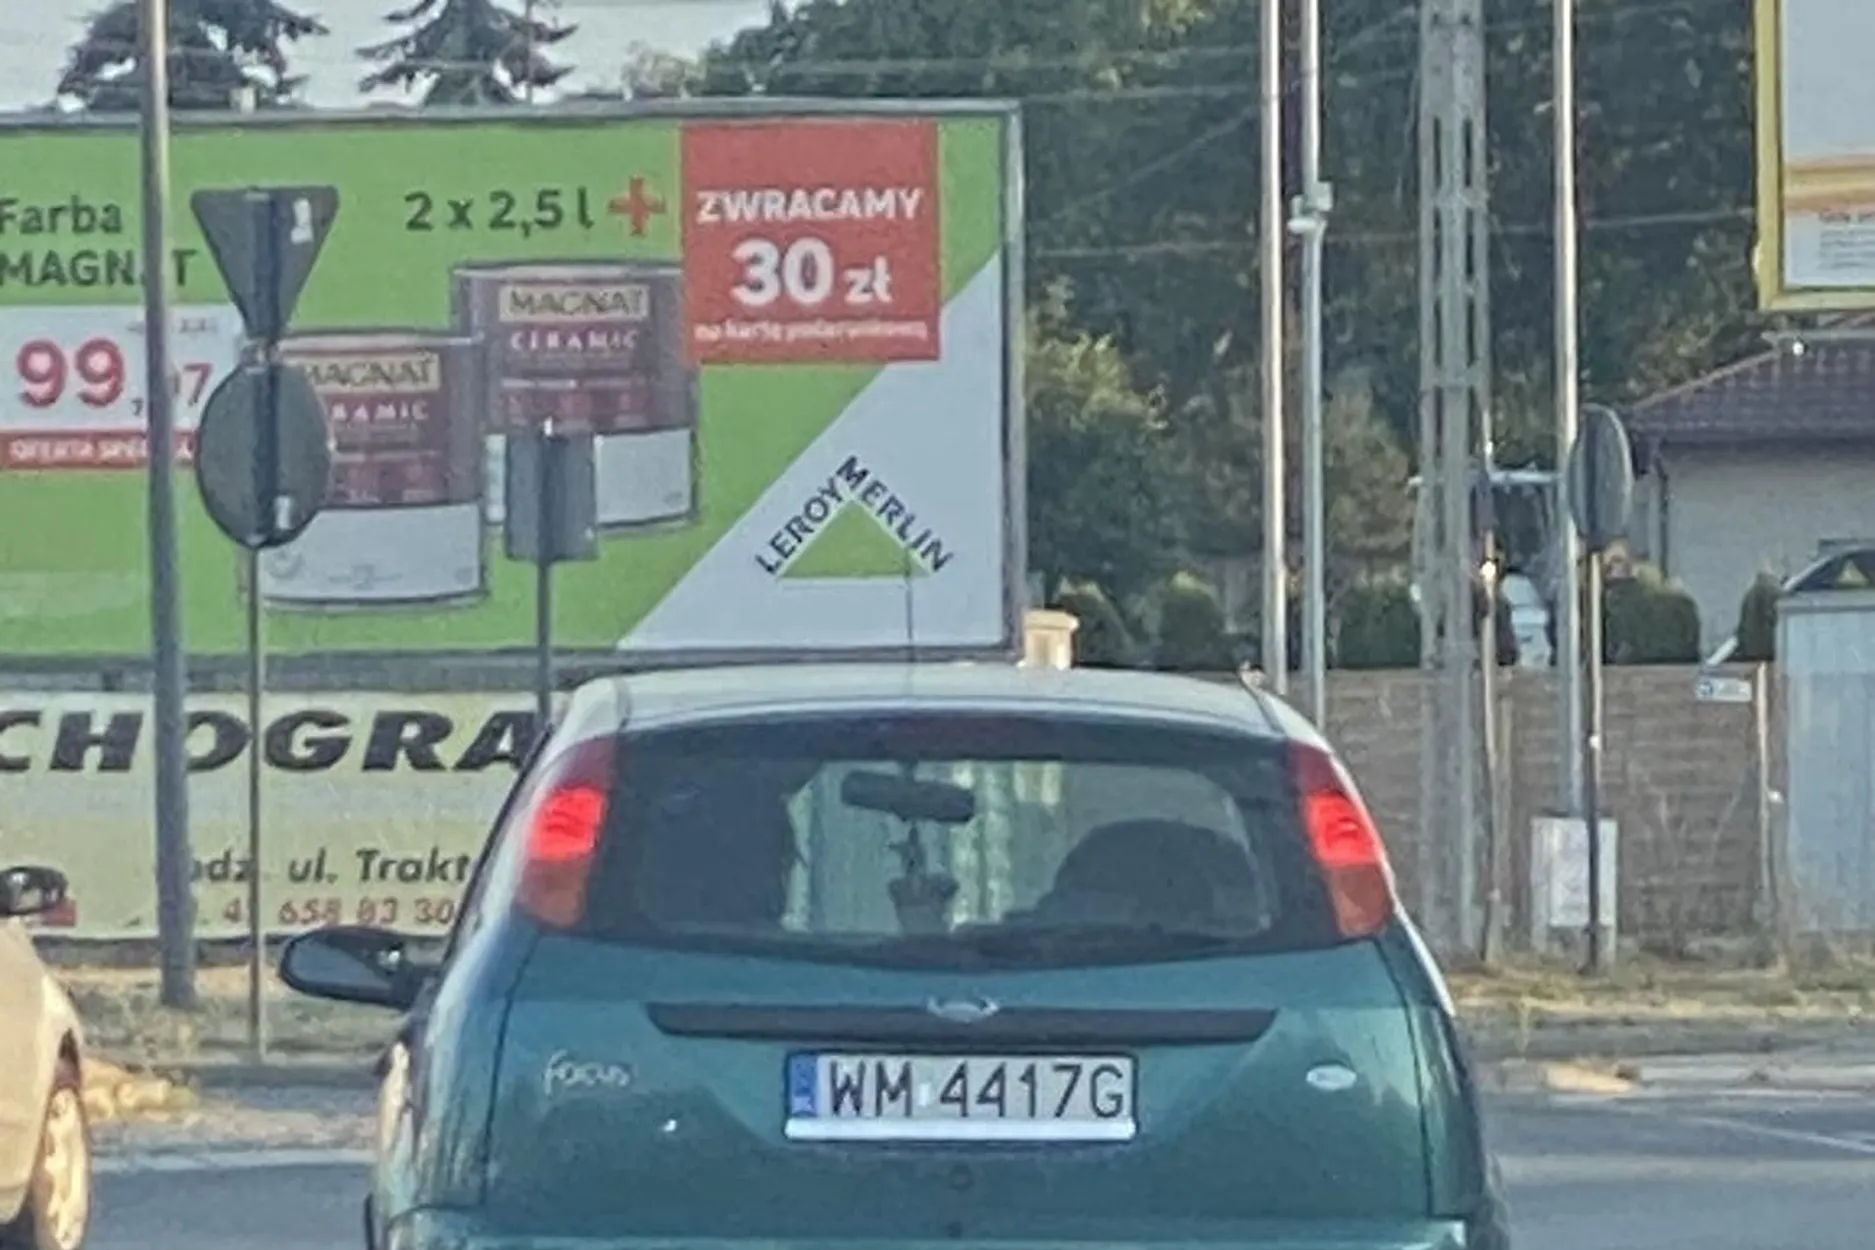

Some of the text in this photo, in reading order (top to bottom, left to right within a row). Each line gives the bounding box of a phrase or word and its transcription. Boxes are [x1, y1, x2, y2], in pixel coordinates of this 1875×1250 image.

[0, 194, 122, 234] Farba
[404, 190, 433, 231] 2
[447, 199, 475, 230] x
[488, 190, 563, 238] 2,5
[696, 187, 923, 224] ZWRACAMY
[0, 249, 198, 287] MAGNT
[730, 236, 892, 306] 30 zł
[331, 402, 429, 421] RAMIC
[755, 477, 844, 575] LEROY
[836, 454, 955, 573] MERLIN
[288, 848, 338, 884] ul.
[830, 1060, 1125, 1119] WM 4417G
